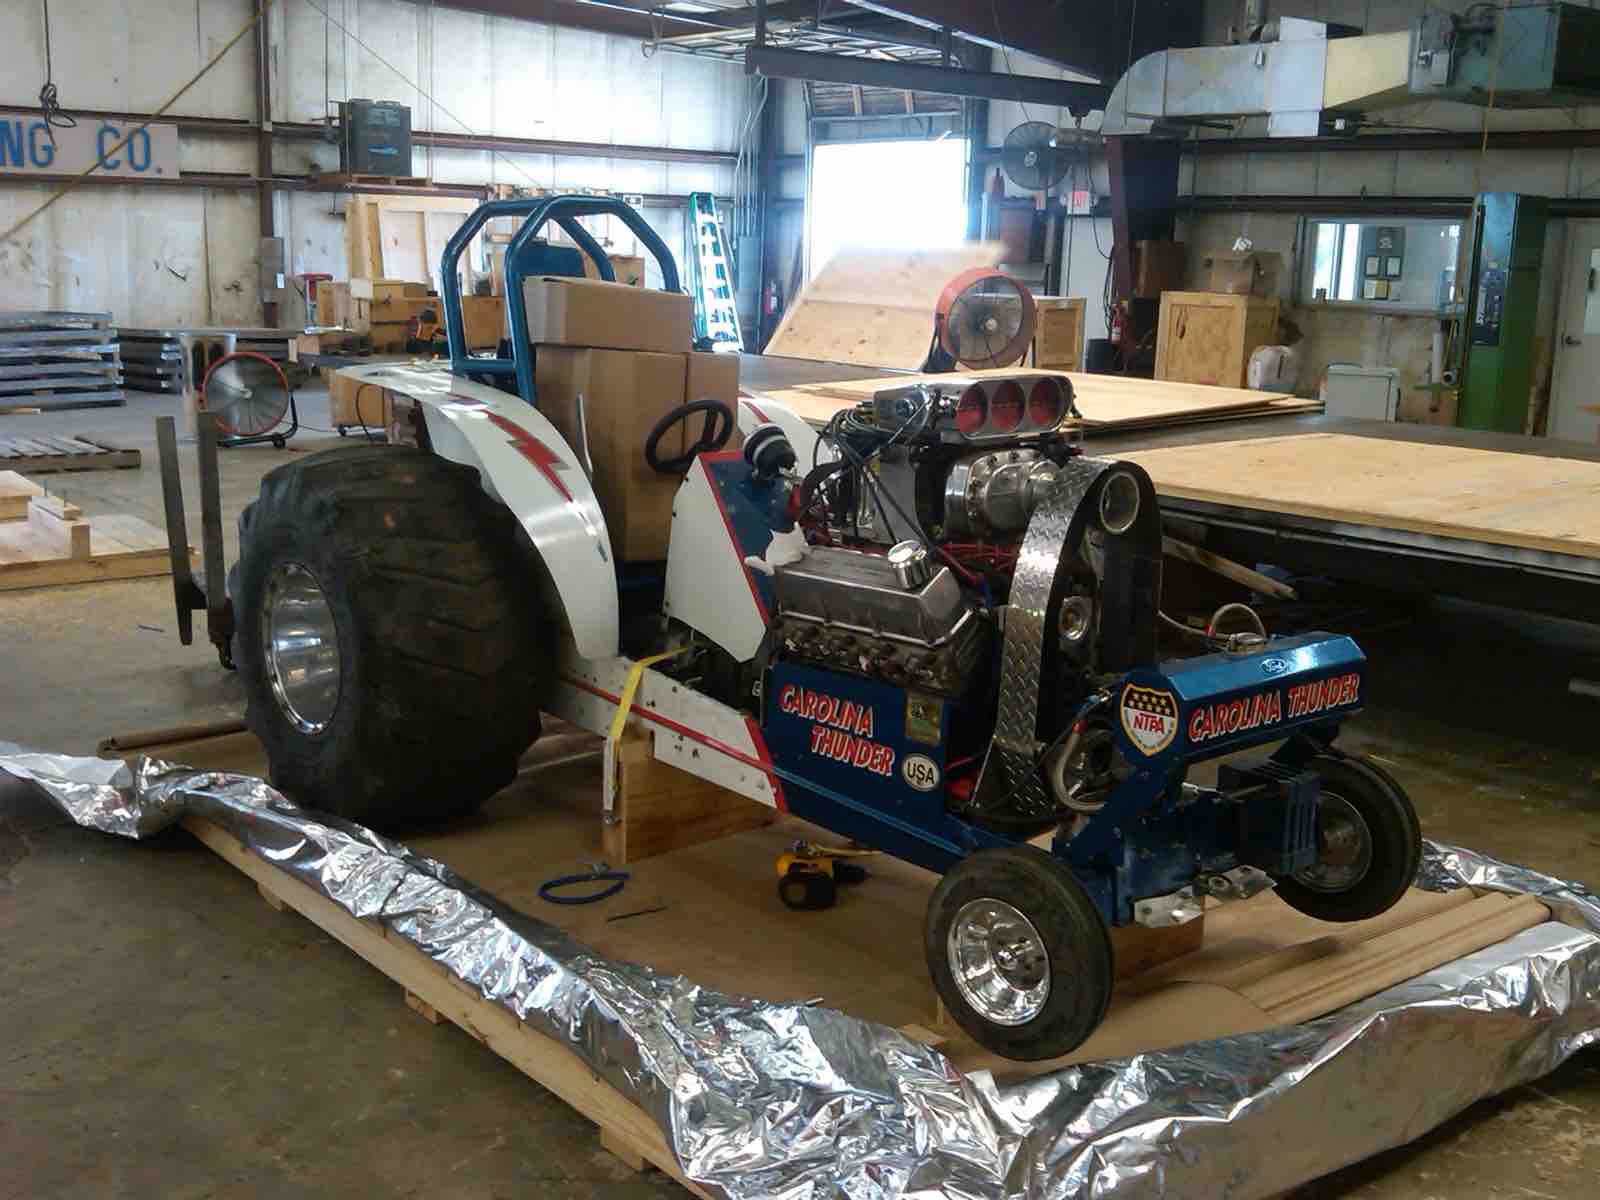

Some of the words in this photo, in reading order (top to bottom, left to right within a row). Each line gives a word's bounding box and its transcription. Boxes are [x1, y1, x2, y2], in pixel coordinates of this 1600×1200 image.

[0, 121, 54, 168] NG
[97, 127, 163, 174] CO.
[780, 683, 874, 738] CAROLINA
[1133, 713, 1166, 734] NTPA
[1188, 690, 1282, 742] CAROLINA
[1287, 673, 1361, 718] THUNDER
[810, 725, 896, 777] THUNDER
[907, 762, 935, 785] USA
